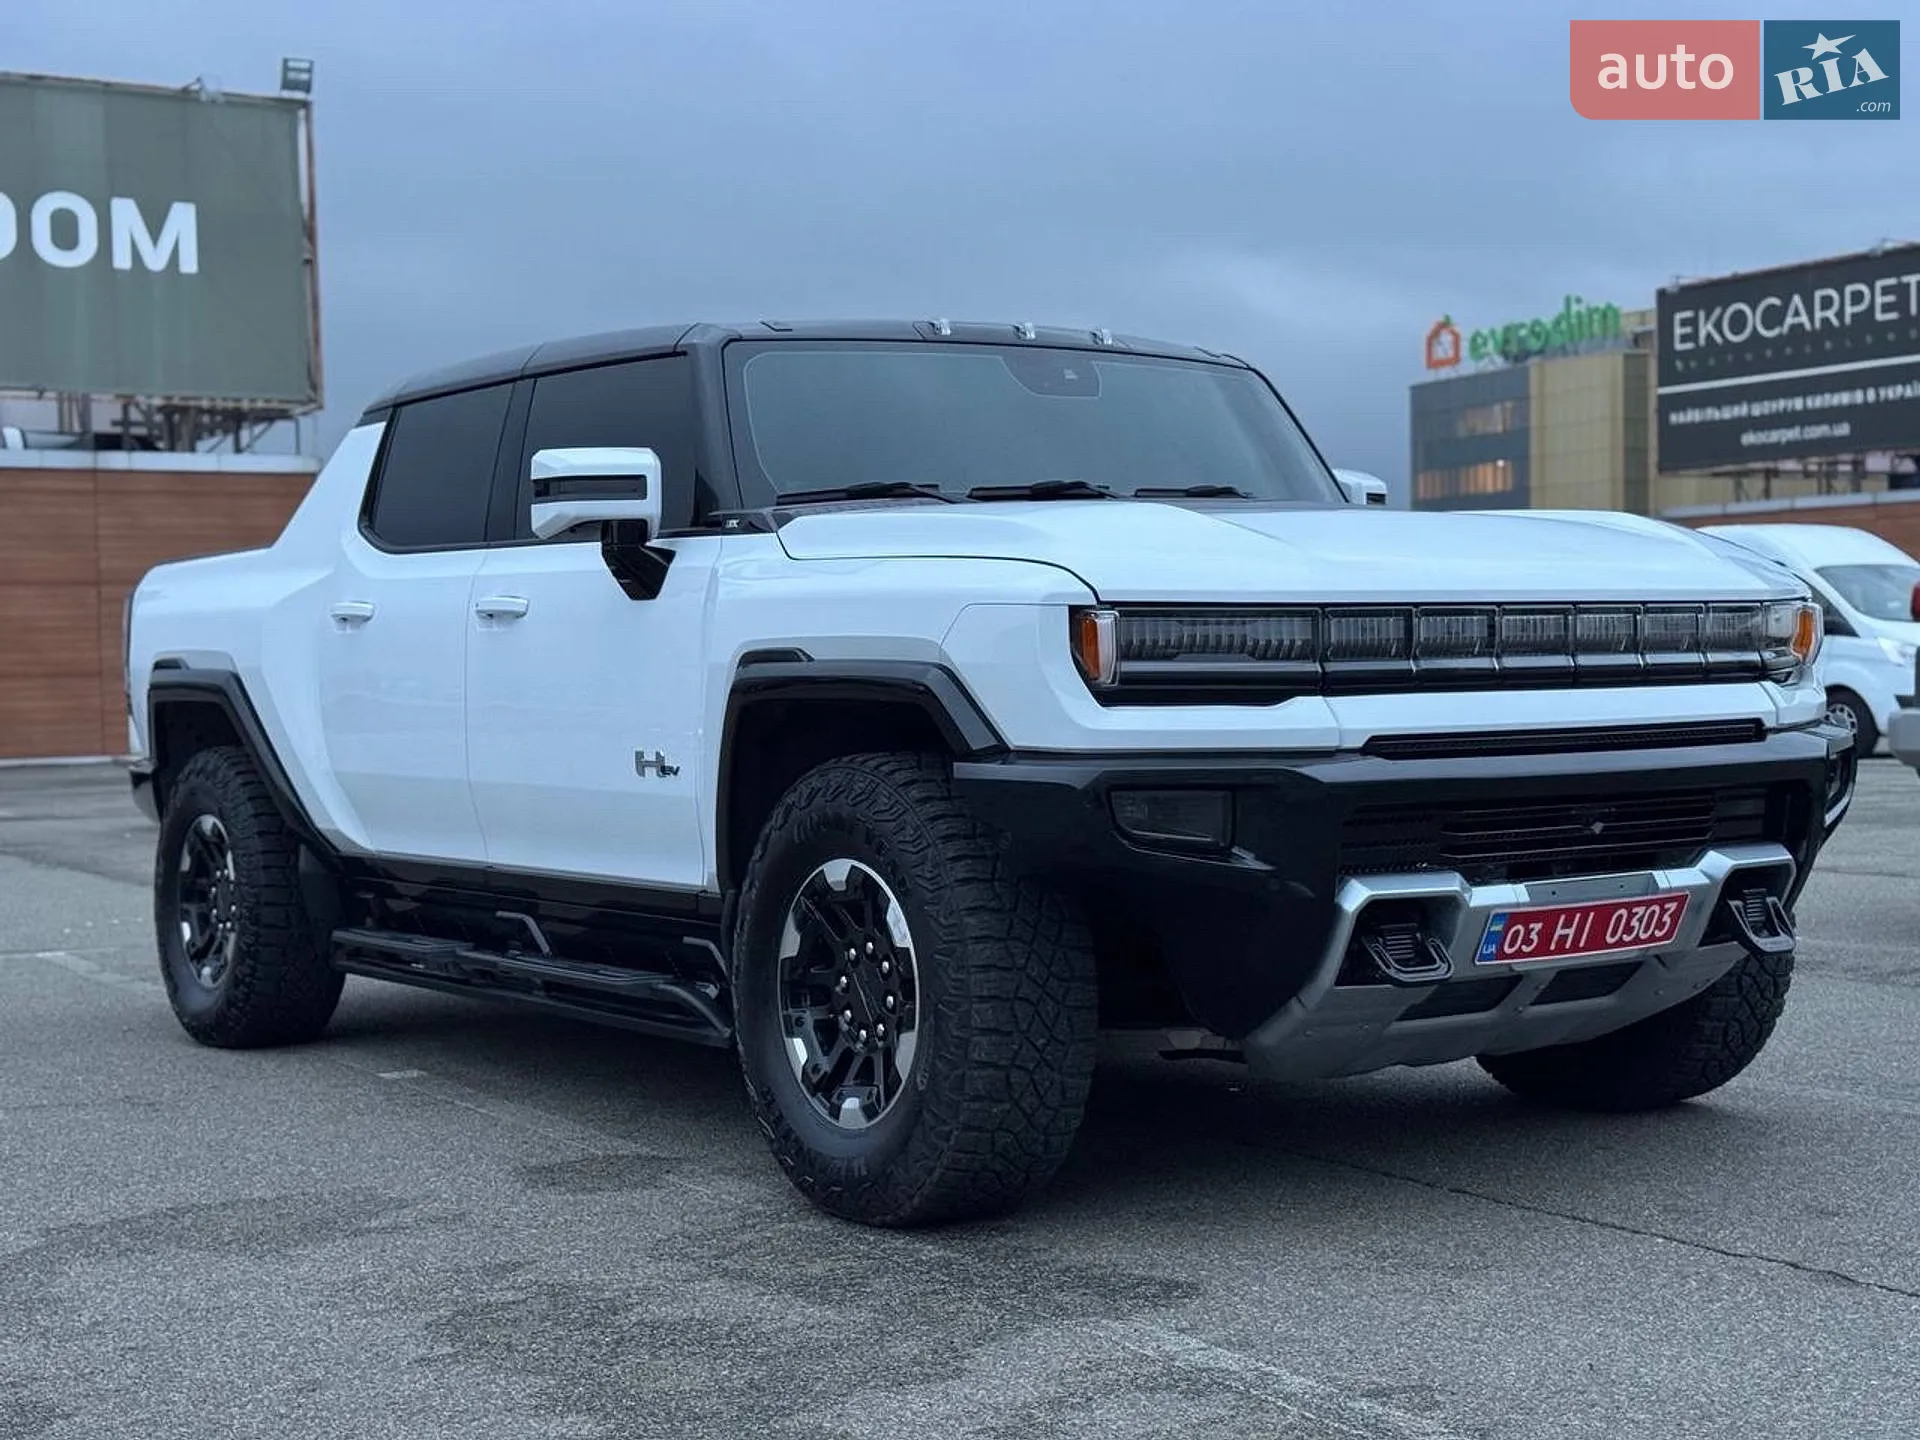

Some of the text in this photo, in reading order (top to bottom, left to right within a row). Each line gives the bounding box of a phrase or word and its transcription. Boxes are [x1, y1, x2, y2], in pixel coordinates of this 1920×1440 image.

[0, 188, 199, 275] OM
[1673, 273, 1920, 352] EKOCARPET
[1503, 902, 1679, 954] 03 HI 0303
